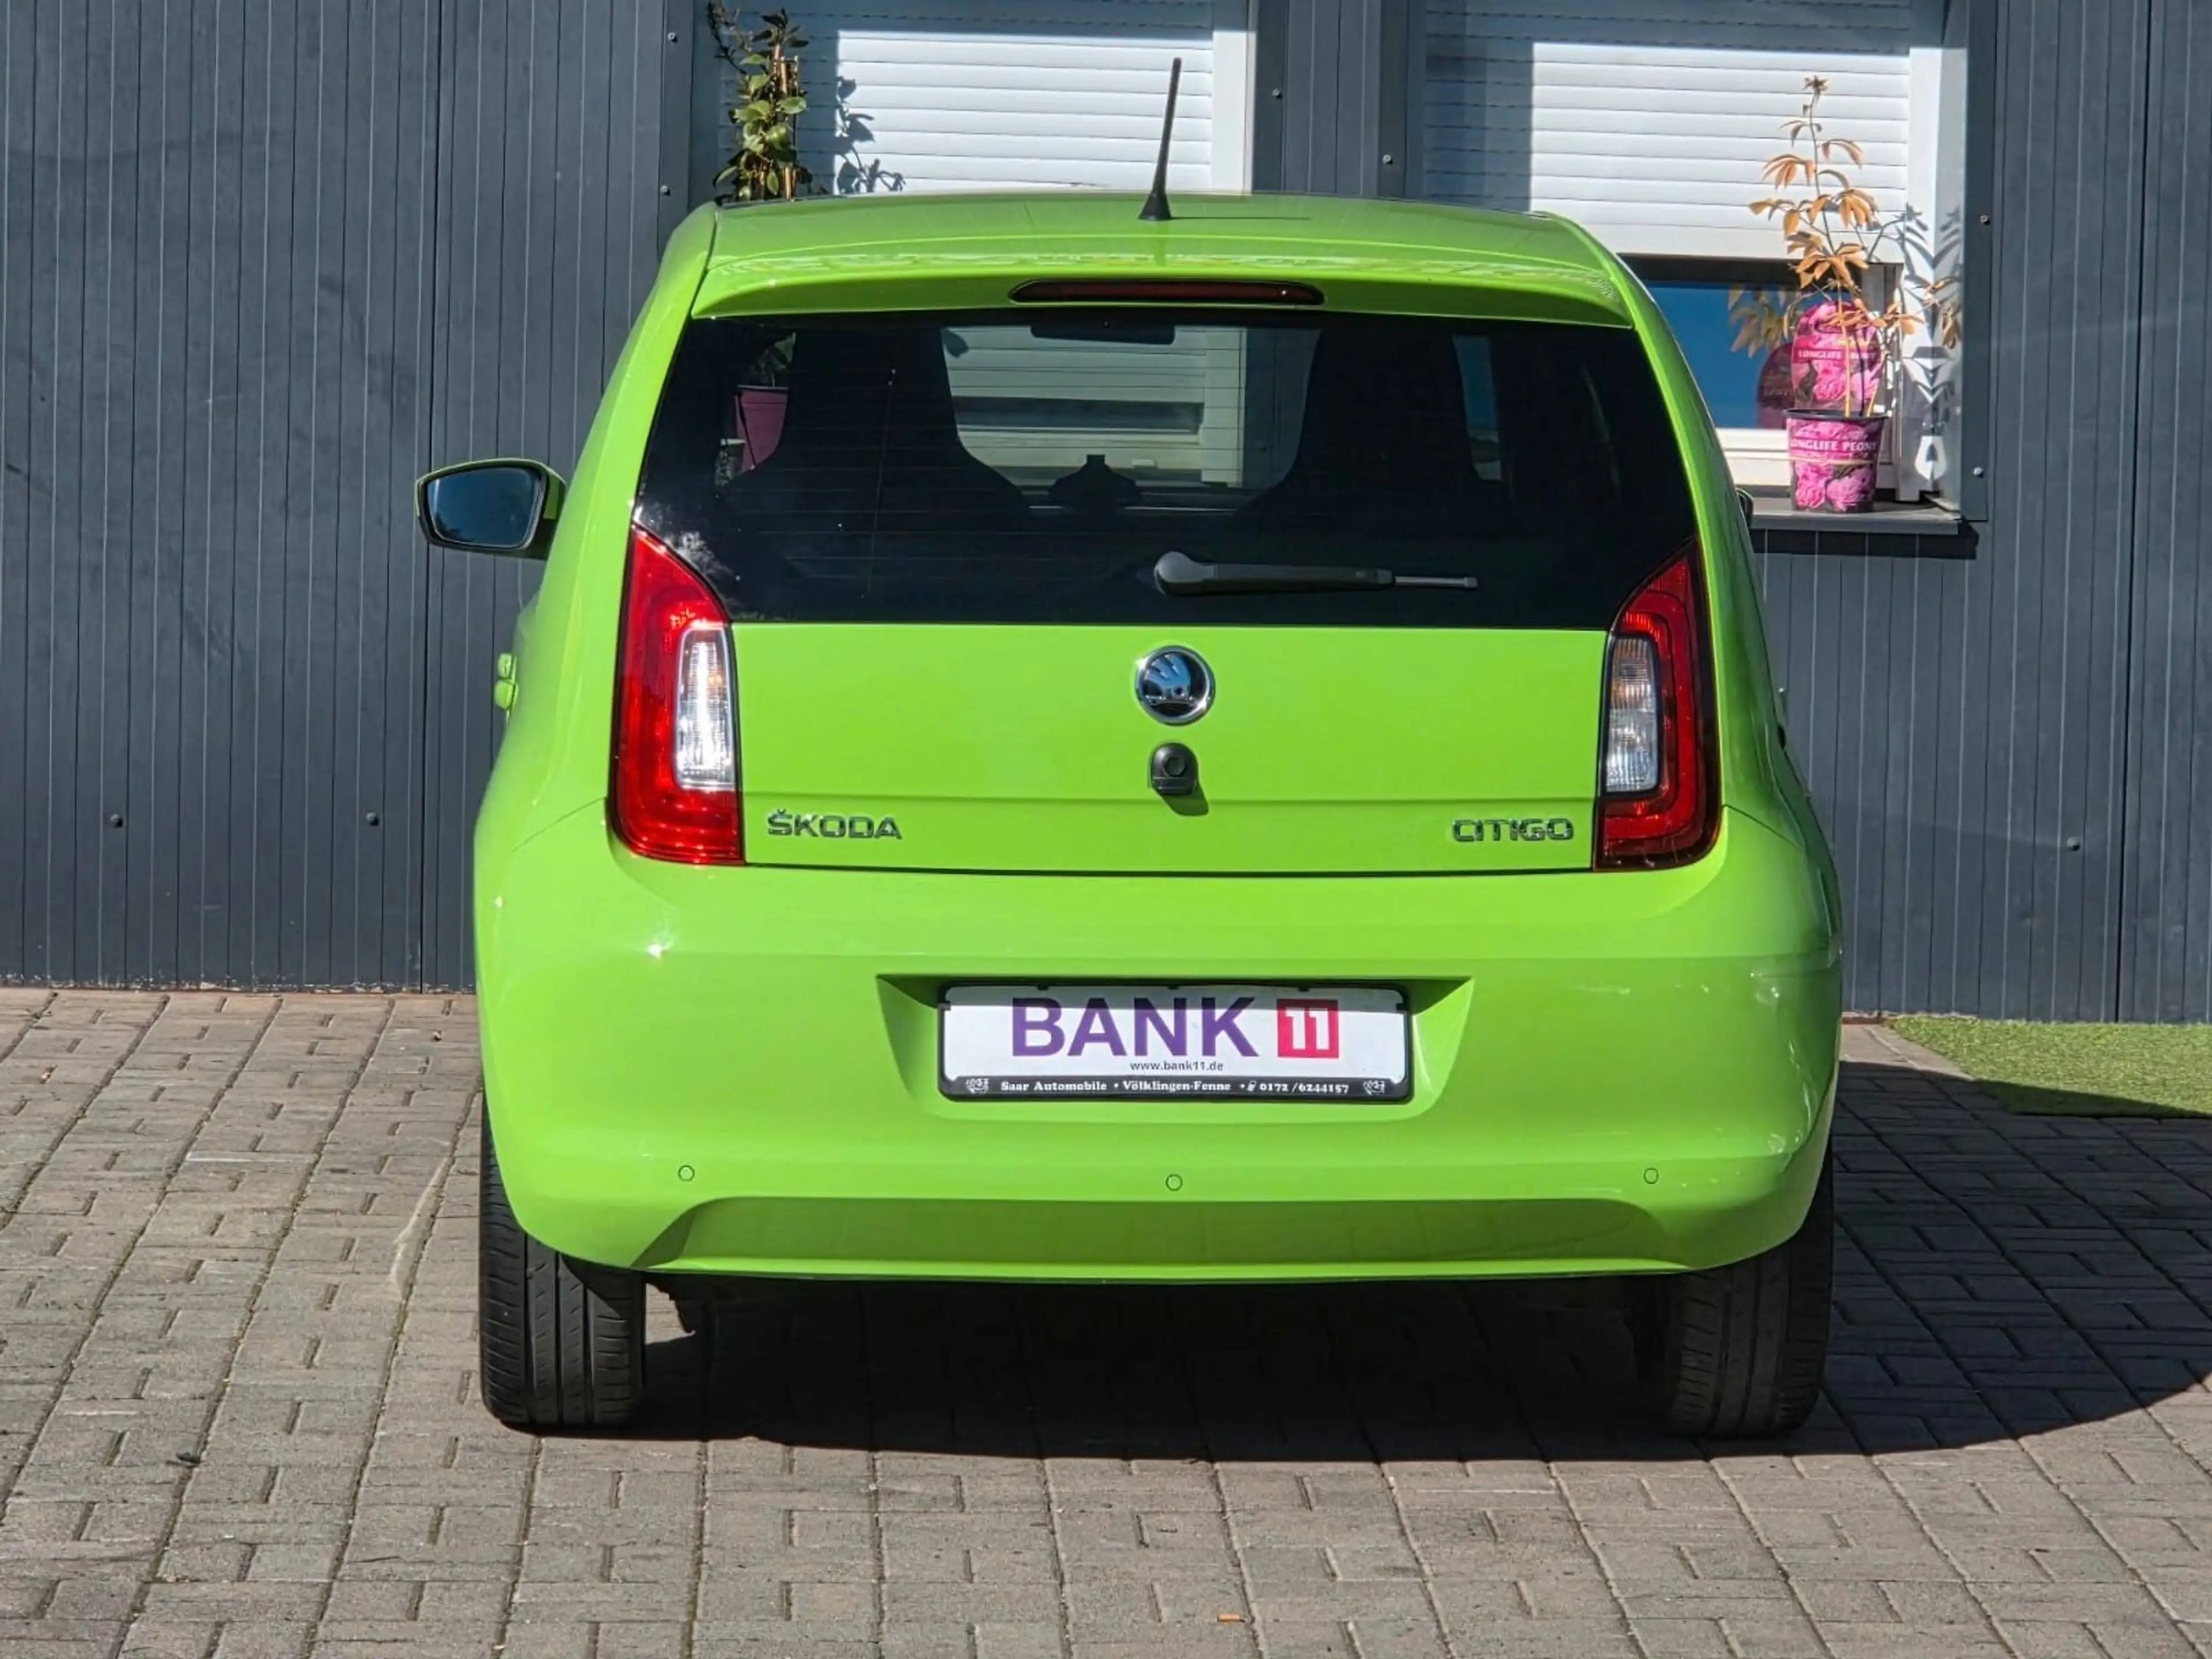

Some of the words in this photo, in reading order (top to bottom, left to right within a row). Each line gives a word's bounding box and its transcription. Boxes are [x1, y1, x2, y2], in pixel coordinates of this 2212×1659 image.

[768, 808, 903, 839] ŠKODA
[1452, 819, 1574, 842] CITIGO
[1012, 997, 1259, 1057] BANK
[1285, 1007, 1330, 1050] 11
[1130, 1060, 1224, 1071] www.bank11.de
[1000, 1081, 1029, 1091] Saar
[1033, 1081, 1108, 1091] Automobile
[1123, 1081, 1231, 1092] Völklingen-Fenne
[1259, 1083, 1289, 1092] 0172
